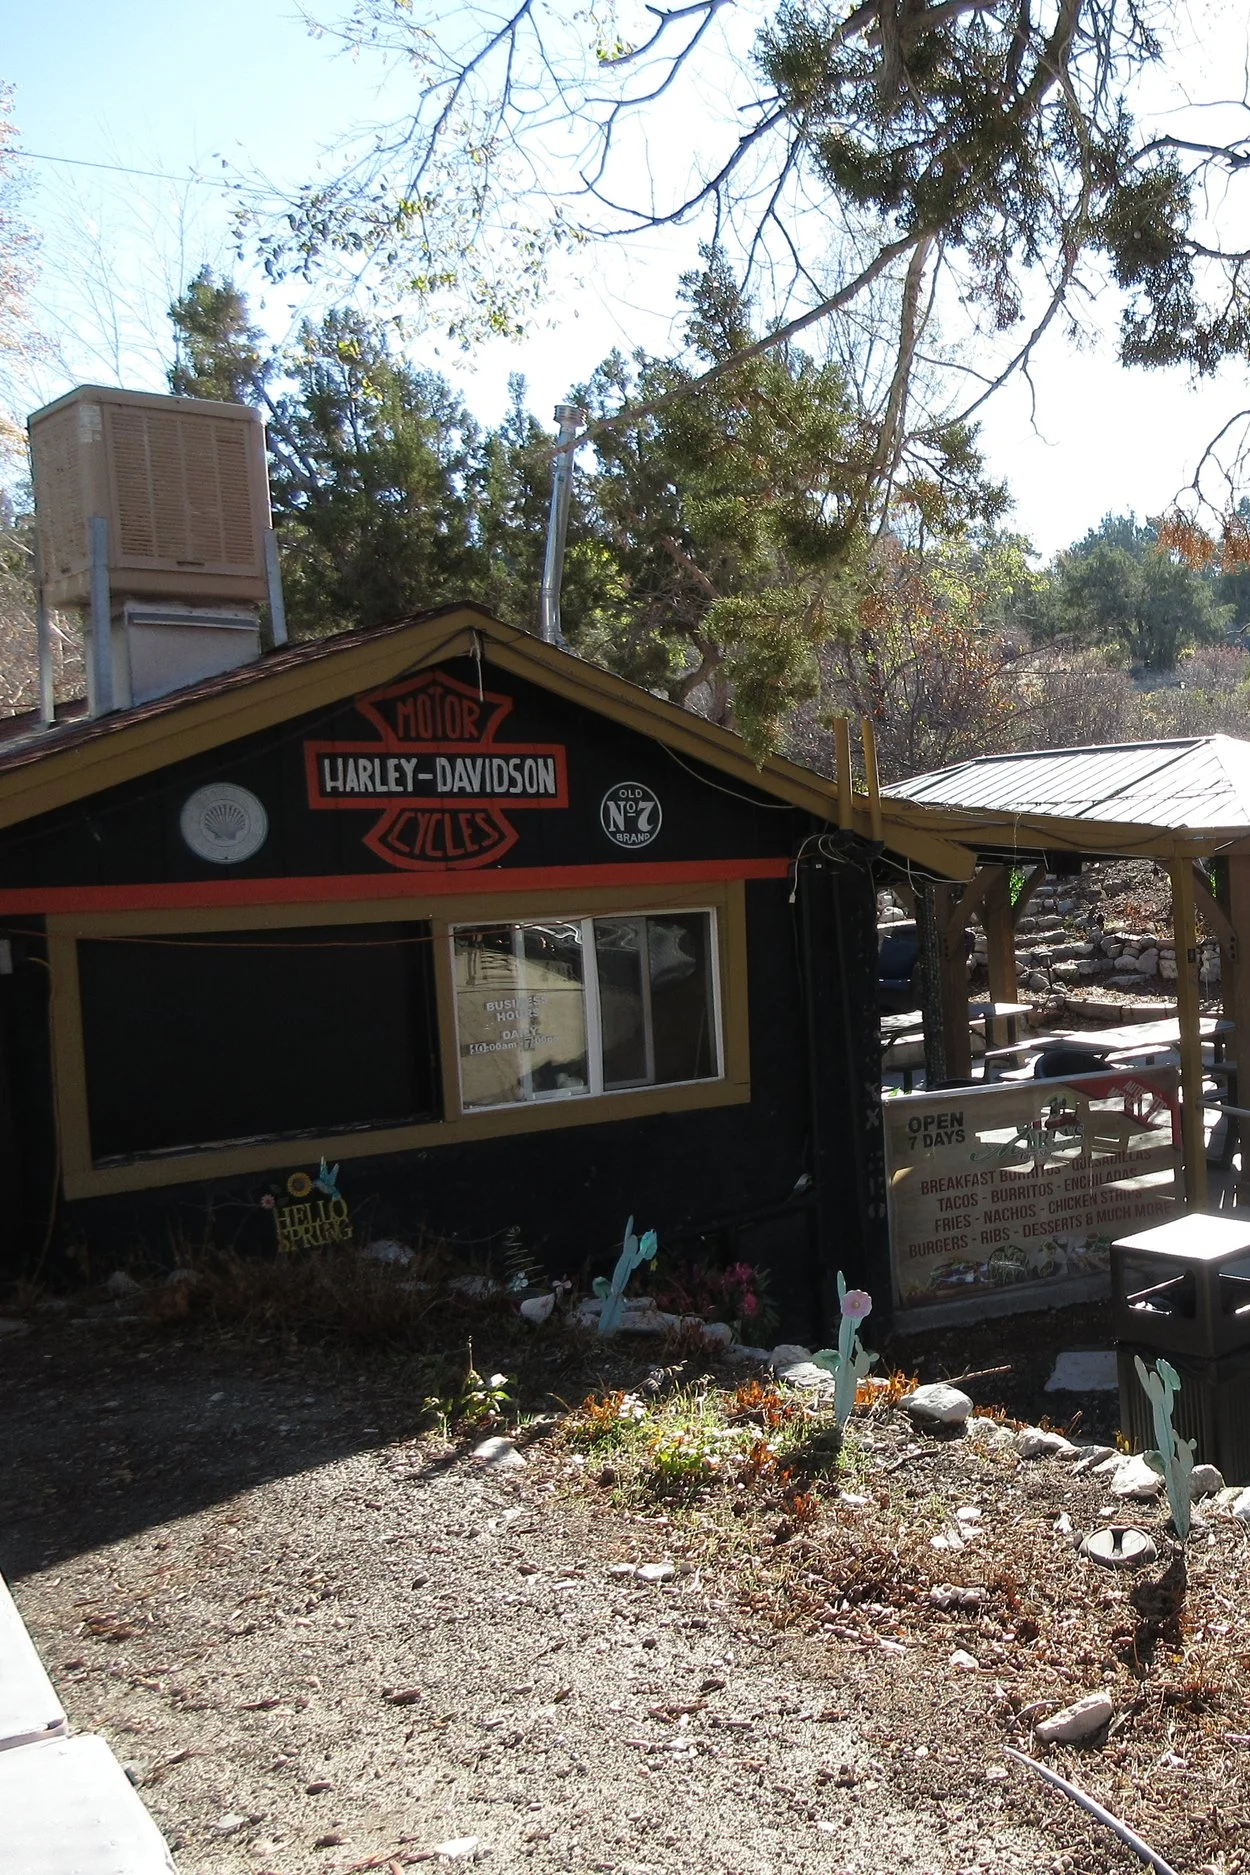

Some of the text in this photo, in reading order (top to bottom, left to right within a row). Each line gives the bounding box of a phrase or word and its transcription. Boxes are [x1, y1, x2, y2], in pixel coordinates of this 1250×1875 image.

[397, 686, 480, 739] MOTOR
[324, 757, 556, 794] HARLEY-DAVIDSON
[619, 790, 643, 798] OLD
[387, 811, 499, 857] CYCLES
[616, 833, 650, 844] BRAND
[908, 1112, 964, 1133] OPEN
[908, 1129, 966, 1150] 7 DAYS
[920, 1170, 996, 1195] BREAKFAST
[937, 1193, 978, 1213] TACOS
[991, 1182, 1054, 1204] BURRITOS
[273, 1197, 349, 1231] HELLO
[935, 1214, 971, 1233] FRIES
[984, 1204, 1037, 1225] NACHOS
[1048, 1193, 1098, 1215] CHICKEN
[1101, 1188, 1142, 1204] STRIPS
[277, 1221, 354, 1253] SPRING
[909, 1234, 969, 1259] BURGERS
[980, 1227, 1010, 1245] RIBS
[1023, 1213, 1083, 1238] DESSERTS
[1086, 1212, 1094, 1226] &
[1096, 1207, 1131, 1224] MUCH
[1135, 1201, 1172, 1217] MORE
